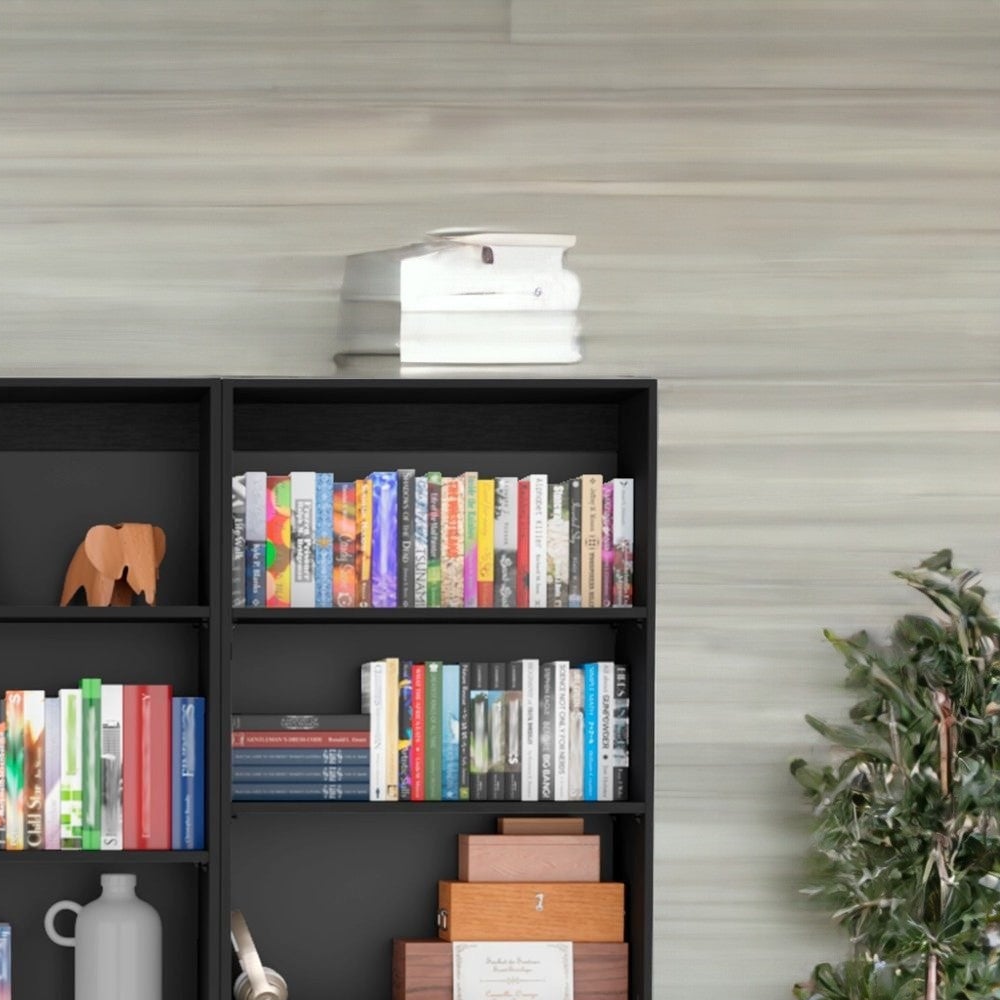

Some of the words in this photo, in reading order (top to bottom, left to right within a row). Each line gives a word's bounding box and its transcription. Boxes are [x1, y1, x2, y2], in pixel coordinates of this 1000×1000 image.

[558, 664, 566, 692] SCIENCE
[558, 693, 566, 709] NOT
[26, 785, 42, 809] Star
[26, 814, 42, 847] Child
